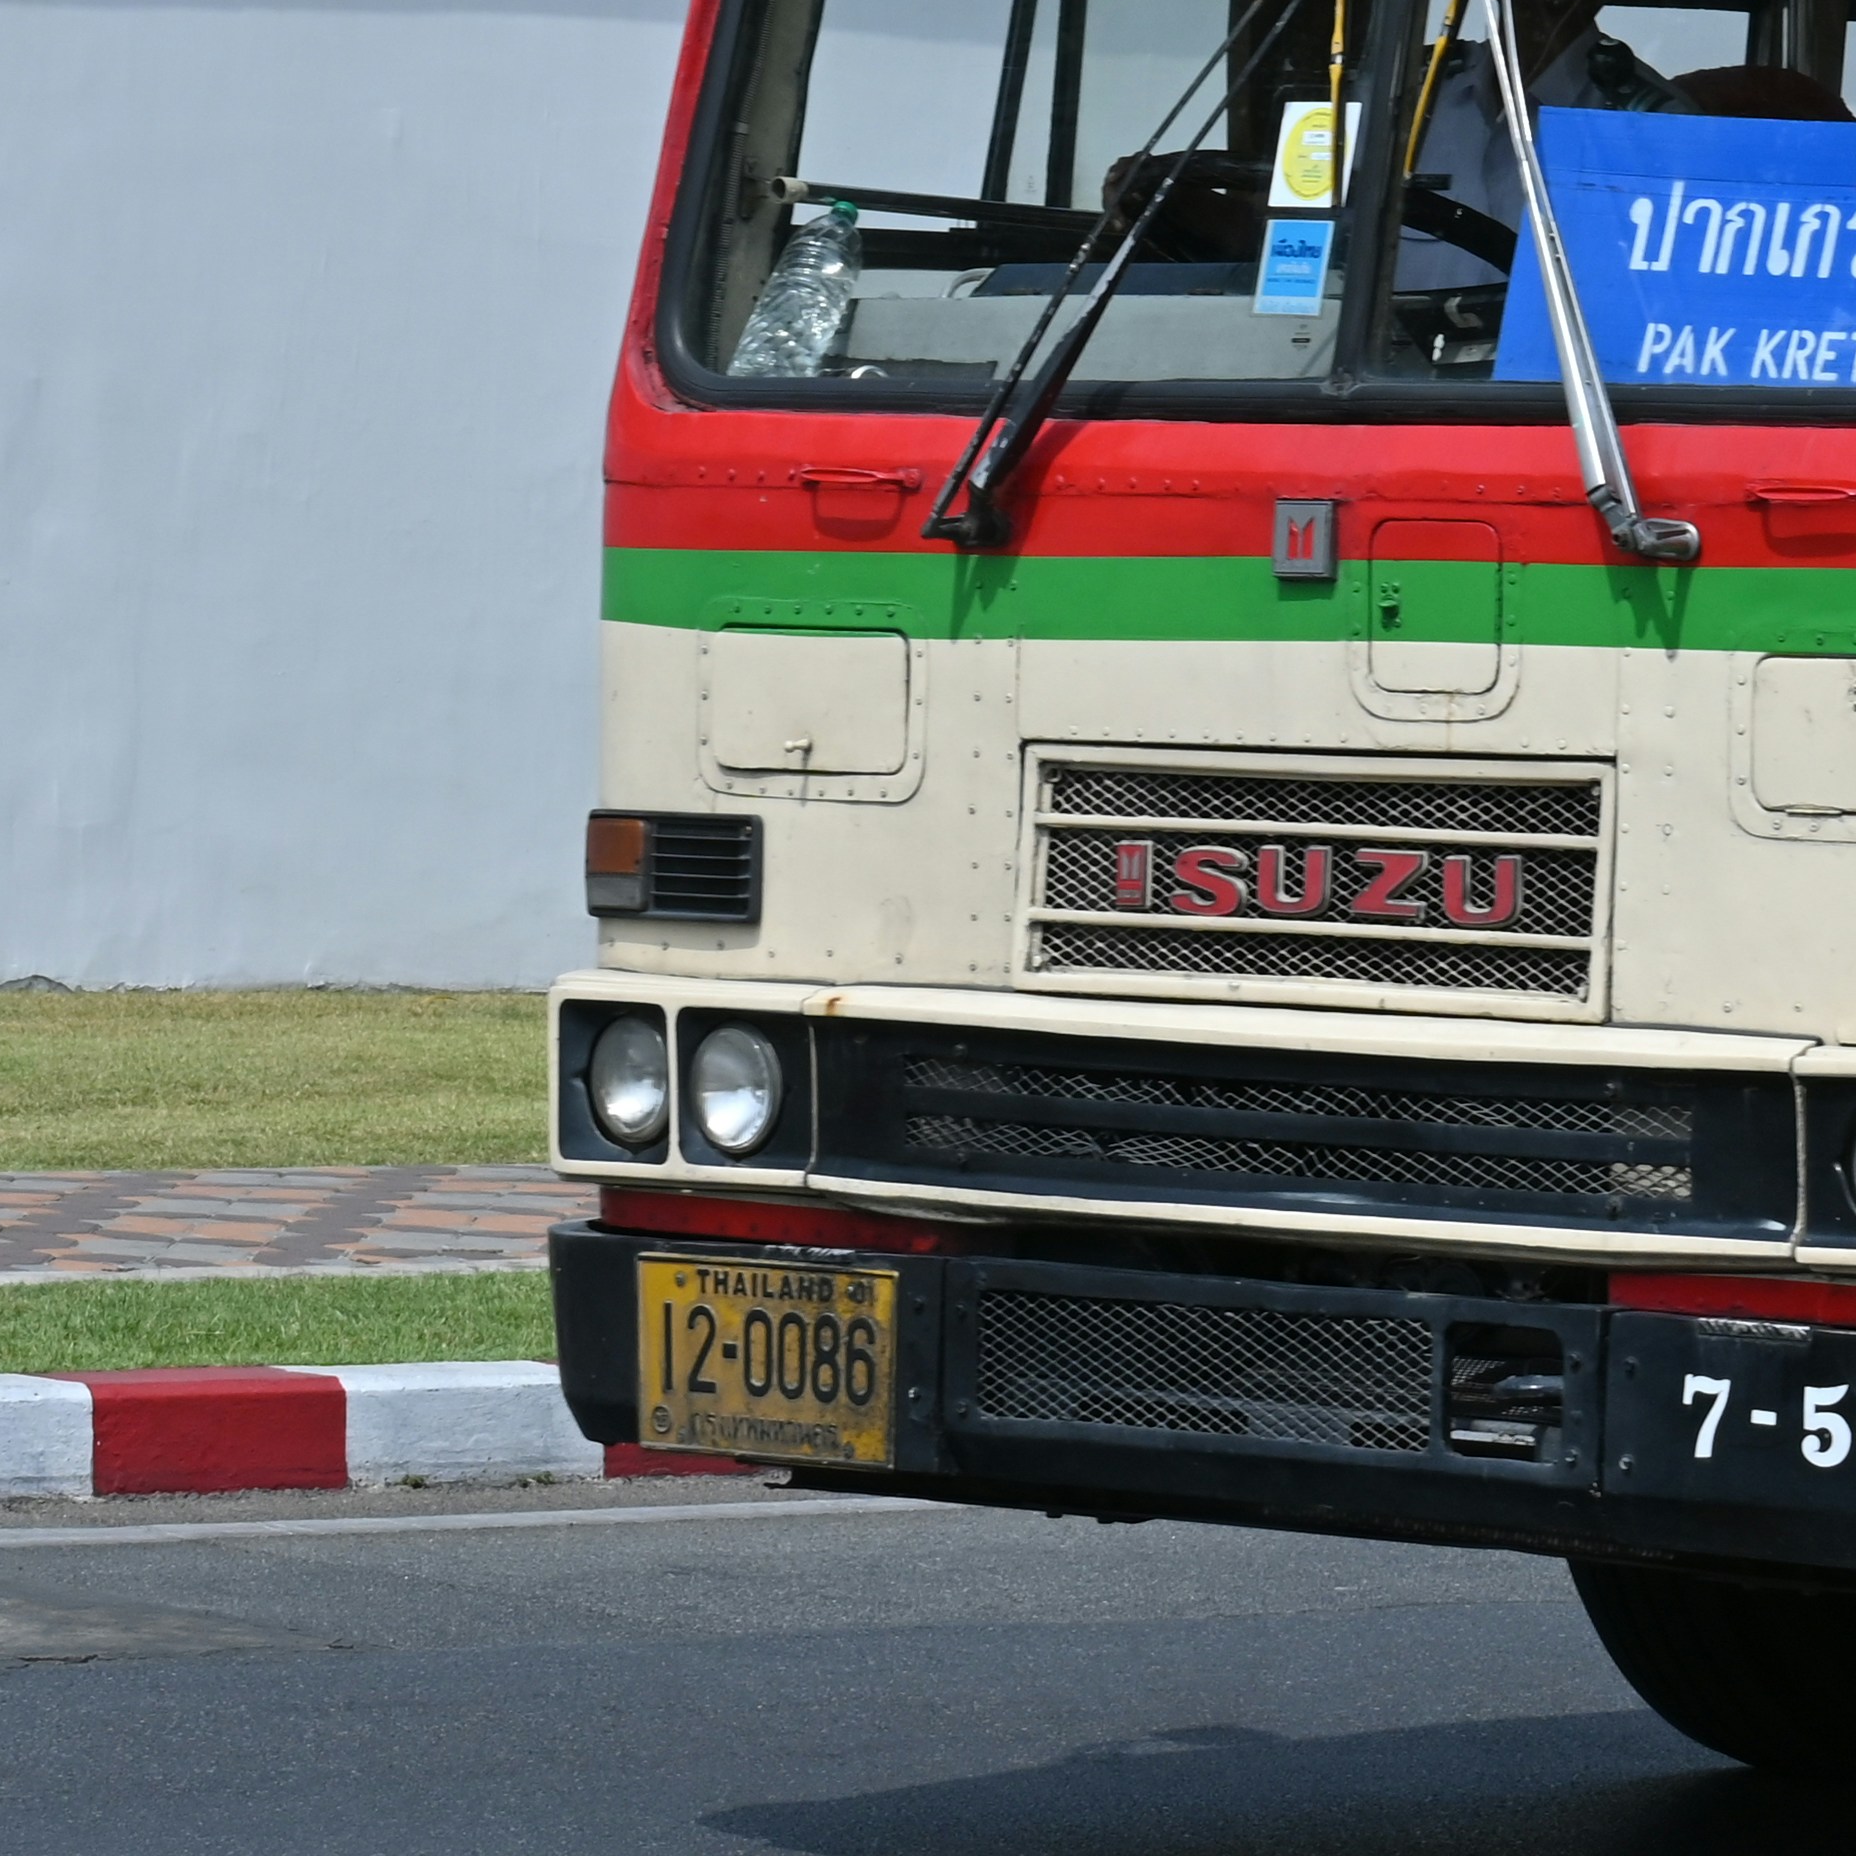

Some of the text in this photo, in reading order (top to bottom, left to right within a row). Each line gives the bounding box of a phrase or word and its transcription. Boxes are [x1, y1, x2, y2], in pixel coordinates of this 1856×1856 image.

[1636, 322, 1736, 377] PAK
[1113, 839, 1523, 928] ISUZU
[696, 1268, 835, 1303] THAILAND
[662, 1301, 877, 1407] 12-0086
